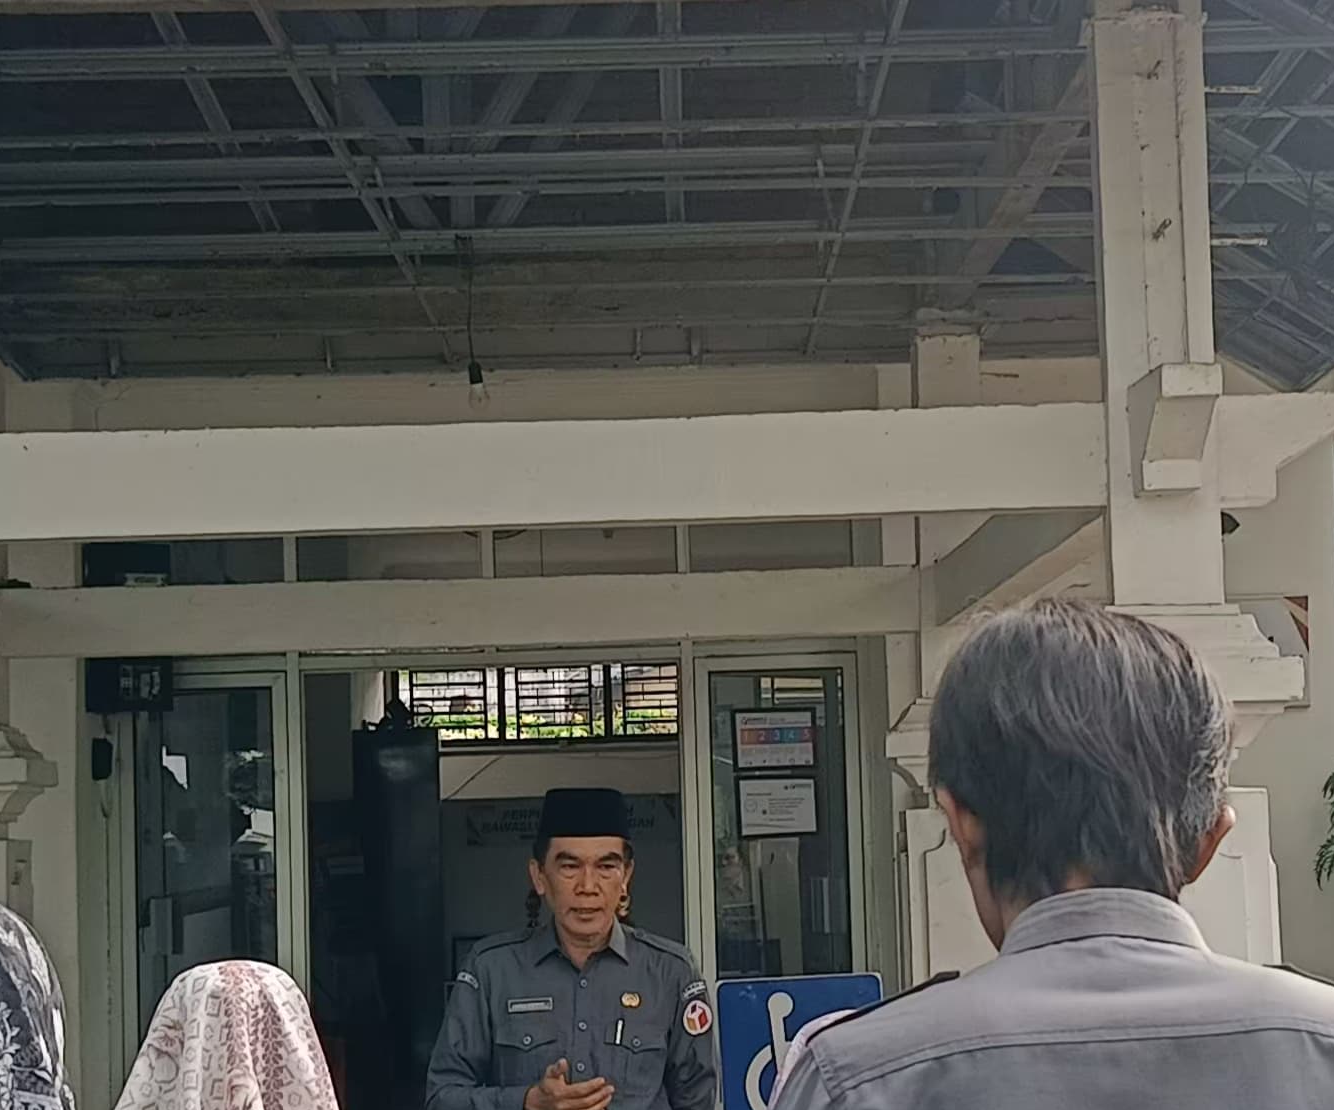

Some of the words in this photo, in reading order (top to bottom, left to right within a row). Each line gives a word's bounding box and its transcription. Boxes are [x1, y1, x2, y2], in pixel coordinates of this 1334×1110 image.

[758, 731, 766, 741] 2
[772, 730, 780, 741] 3
[787, 730, 795, 740] 4
